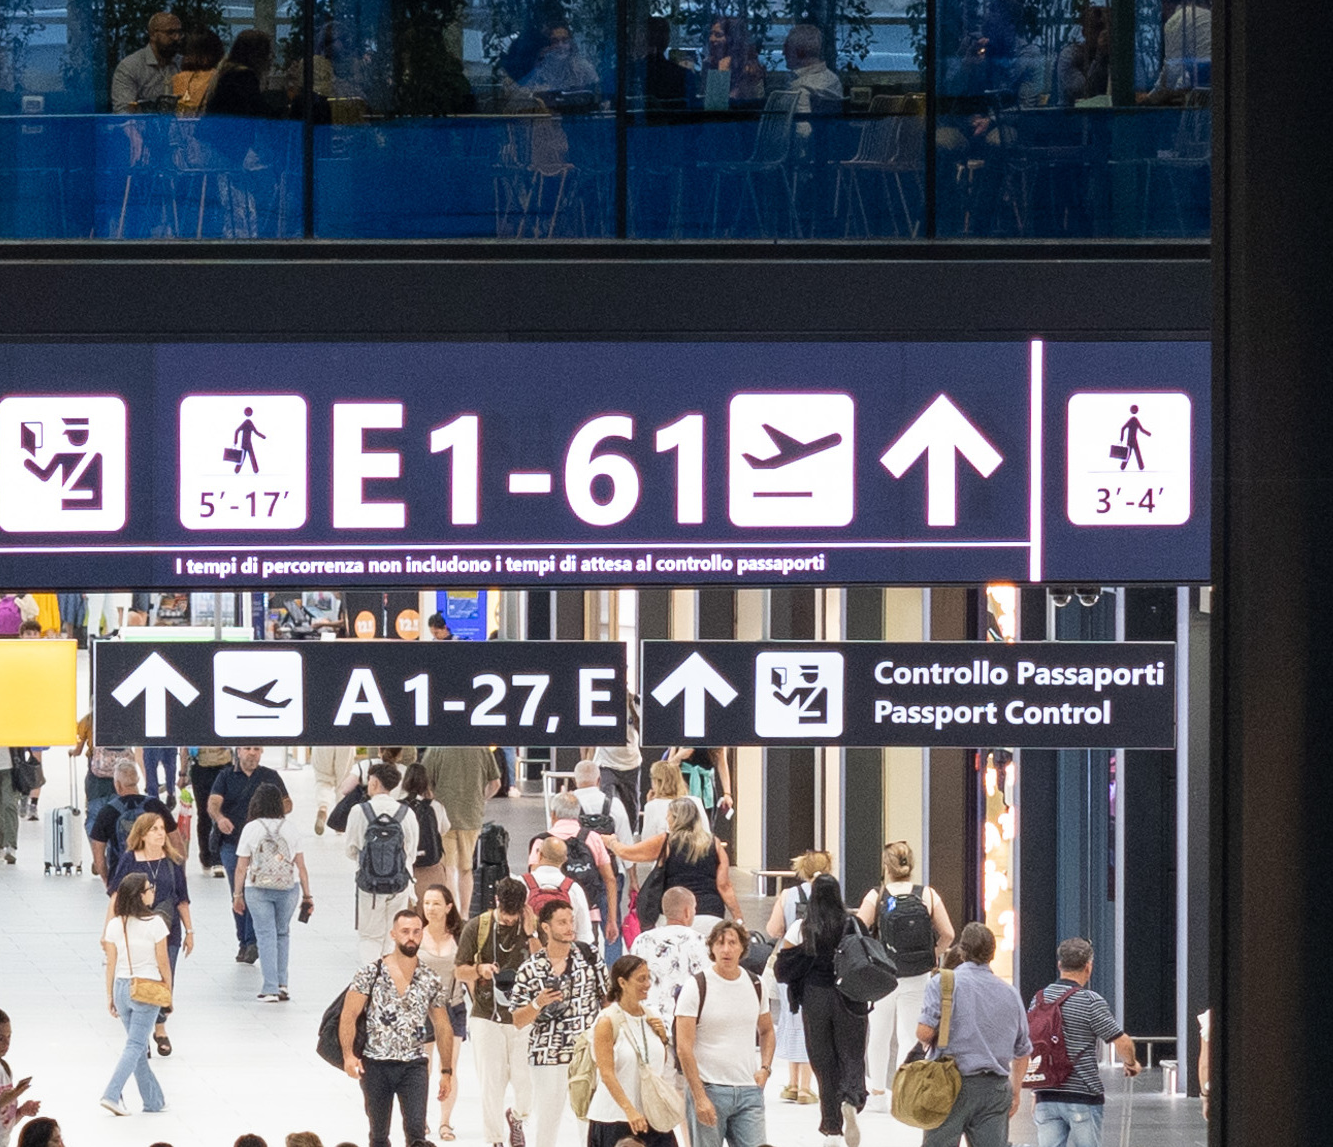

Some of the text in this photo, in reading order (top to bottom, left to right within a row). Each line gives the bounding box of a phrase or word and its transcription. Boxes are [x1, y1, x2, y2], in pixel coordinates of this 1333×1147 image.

[175, 553, 826, 579] I tempi di percorrenza non includono i tempi di attesa al controllo passaporti
[874, 660, 1165, 693] Controllo Passaporti
[874, 699, 1111, 731] Passport Control
